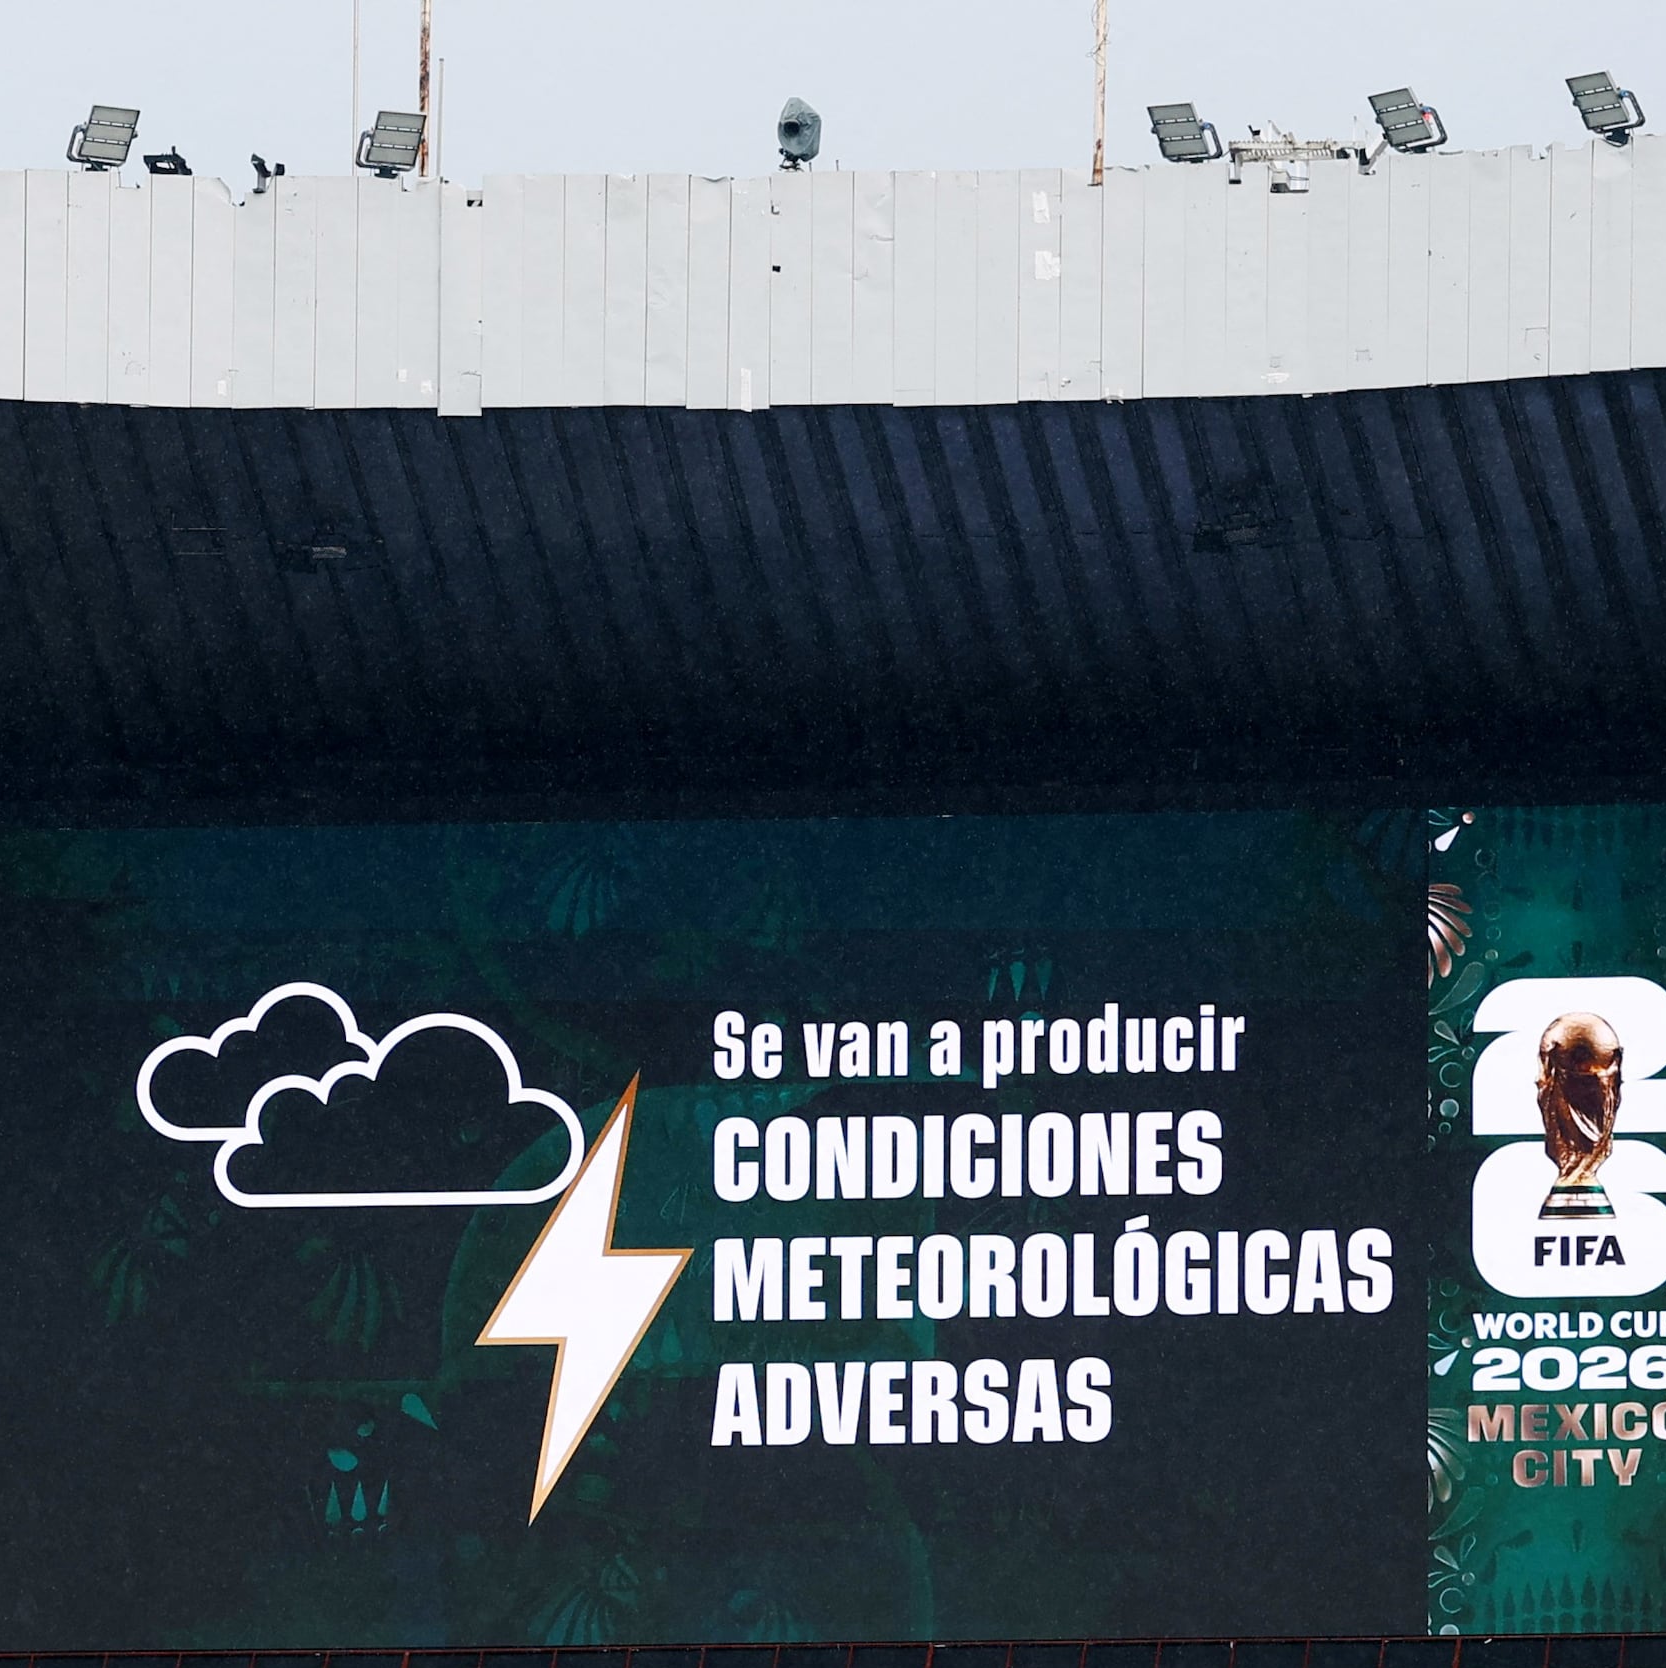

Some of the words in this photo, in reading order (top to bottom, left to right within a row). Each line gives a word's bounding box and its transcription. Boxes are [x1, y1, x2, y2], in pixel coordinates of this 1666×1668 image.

[714, 1011, 783, 1080] Se
[803, 1020, 908, 1078] van
[929, 1020, 961, 1077] a
[983, 1003, 1245, 1088] producir
[713, 1109, 1223, 1203] CONDICIONES
[713, 1215, 1393, 1323] METEOROLÓGICAS
[1534, 1235, 1627, 1266] FIFA
[1472, 1311, 1604, 1340] WORLD
[712, 1356, 1112, 1446] ADVERSAS
[1512, 1447, 1643, 1488] CITY
